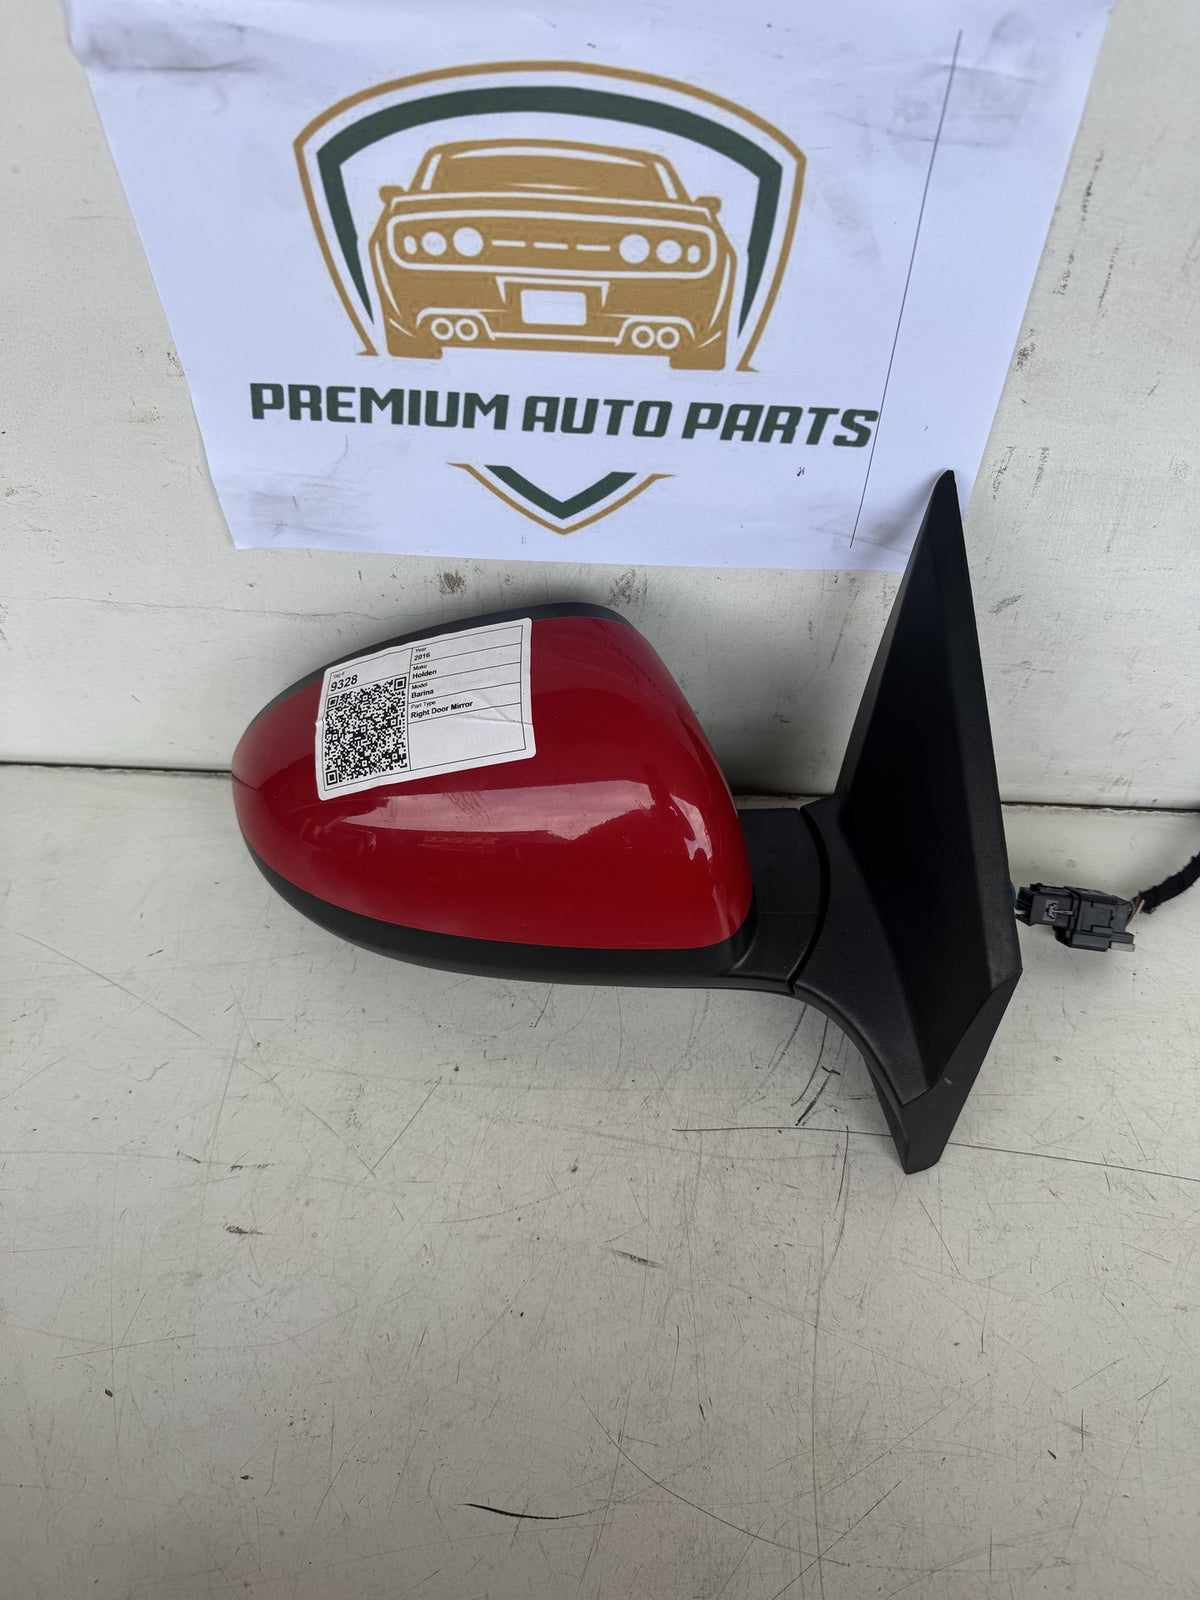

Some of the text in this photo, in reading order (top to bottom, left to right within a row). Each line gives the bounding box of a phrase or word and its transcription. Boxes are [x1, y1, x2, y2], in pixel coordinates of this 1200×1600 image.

[249, 382, 880, 448] PREMIUM AUTO PARTS
[414, 652, 431, 661] 2016
[412, 669, 437, 679] Holden
[330, 674, 358, 692] 9328
[411, 682, 428, 690] Model
[411, 689, 434, 699] Barina
[423, 700, 436, 708] Type
[410, 701, 473, 719] Right Door Mirror
